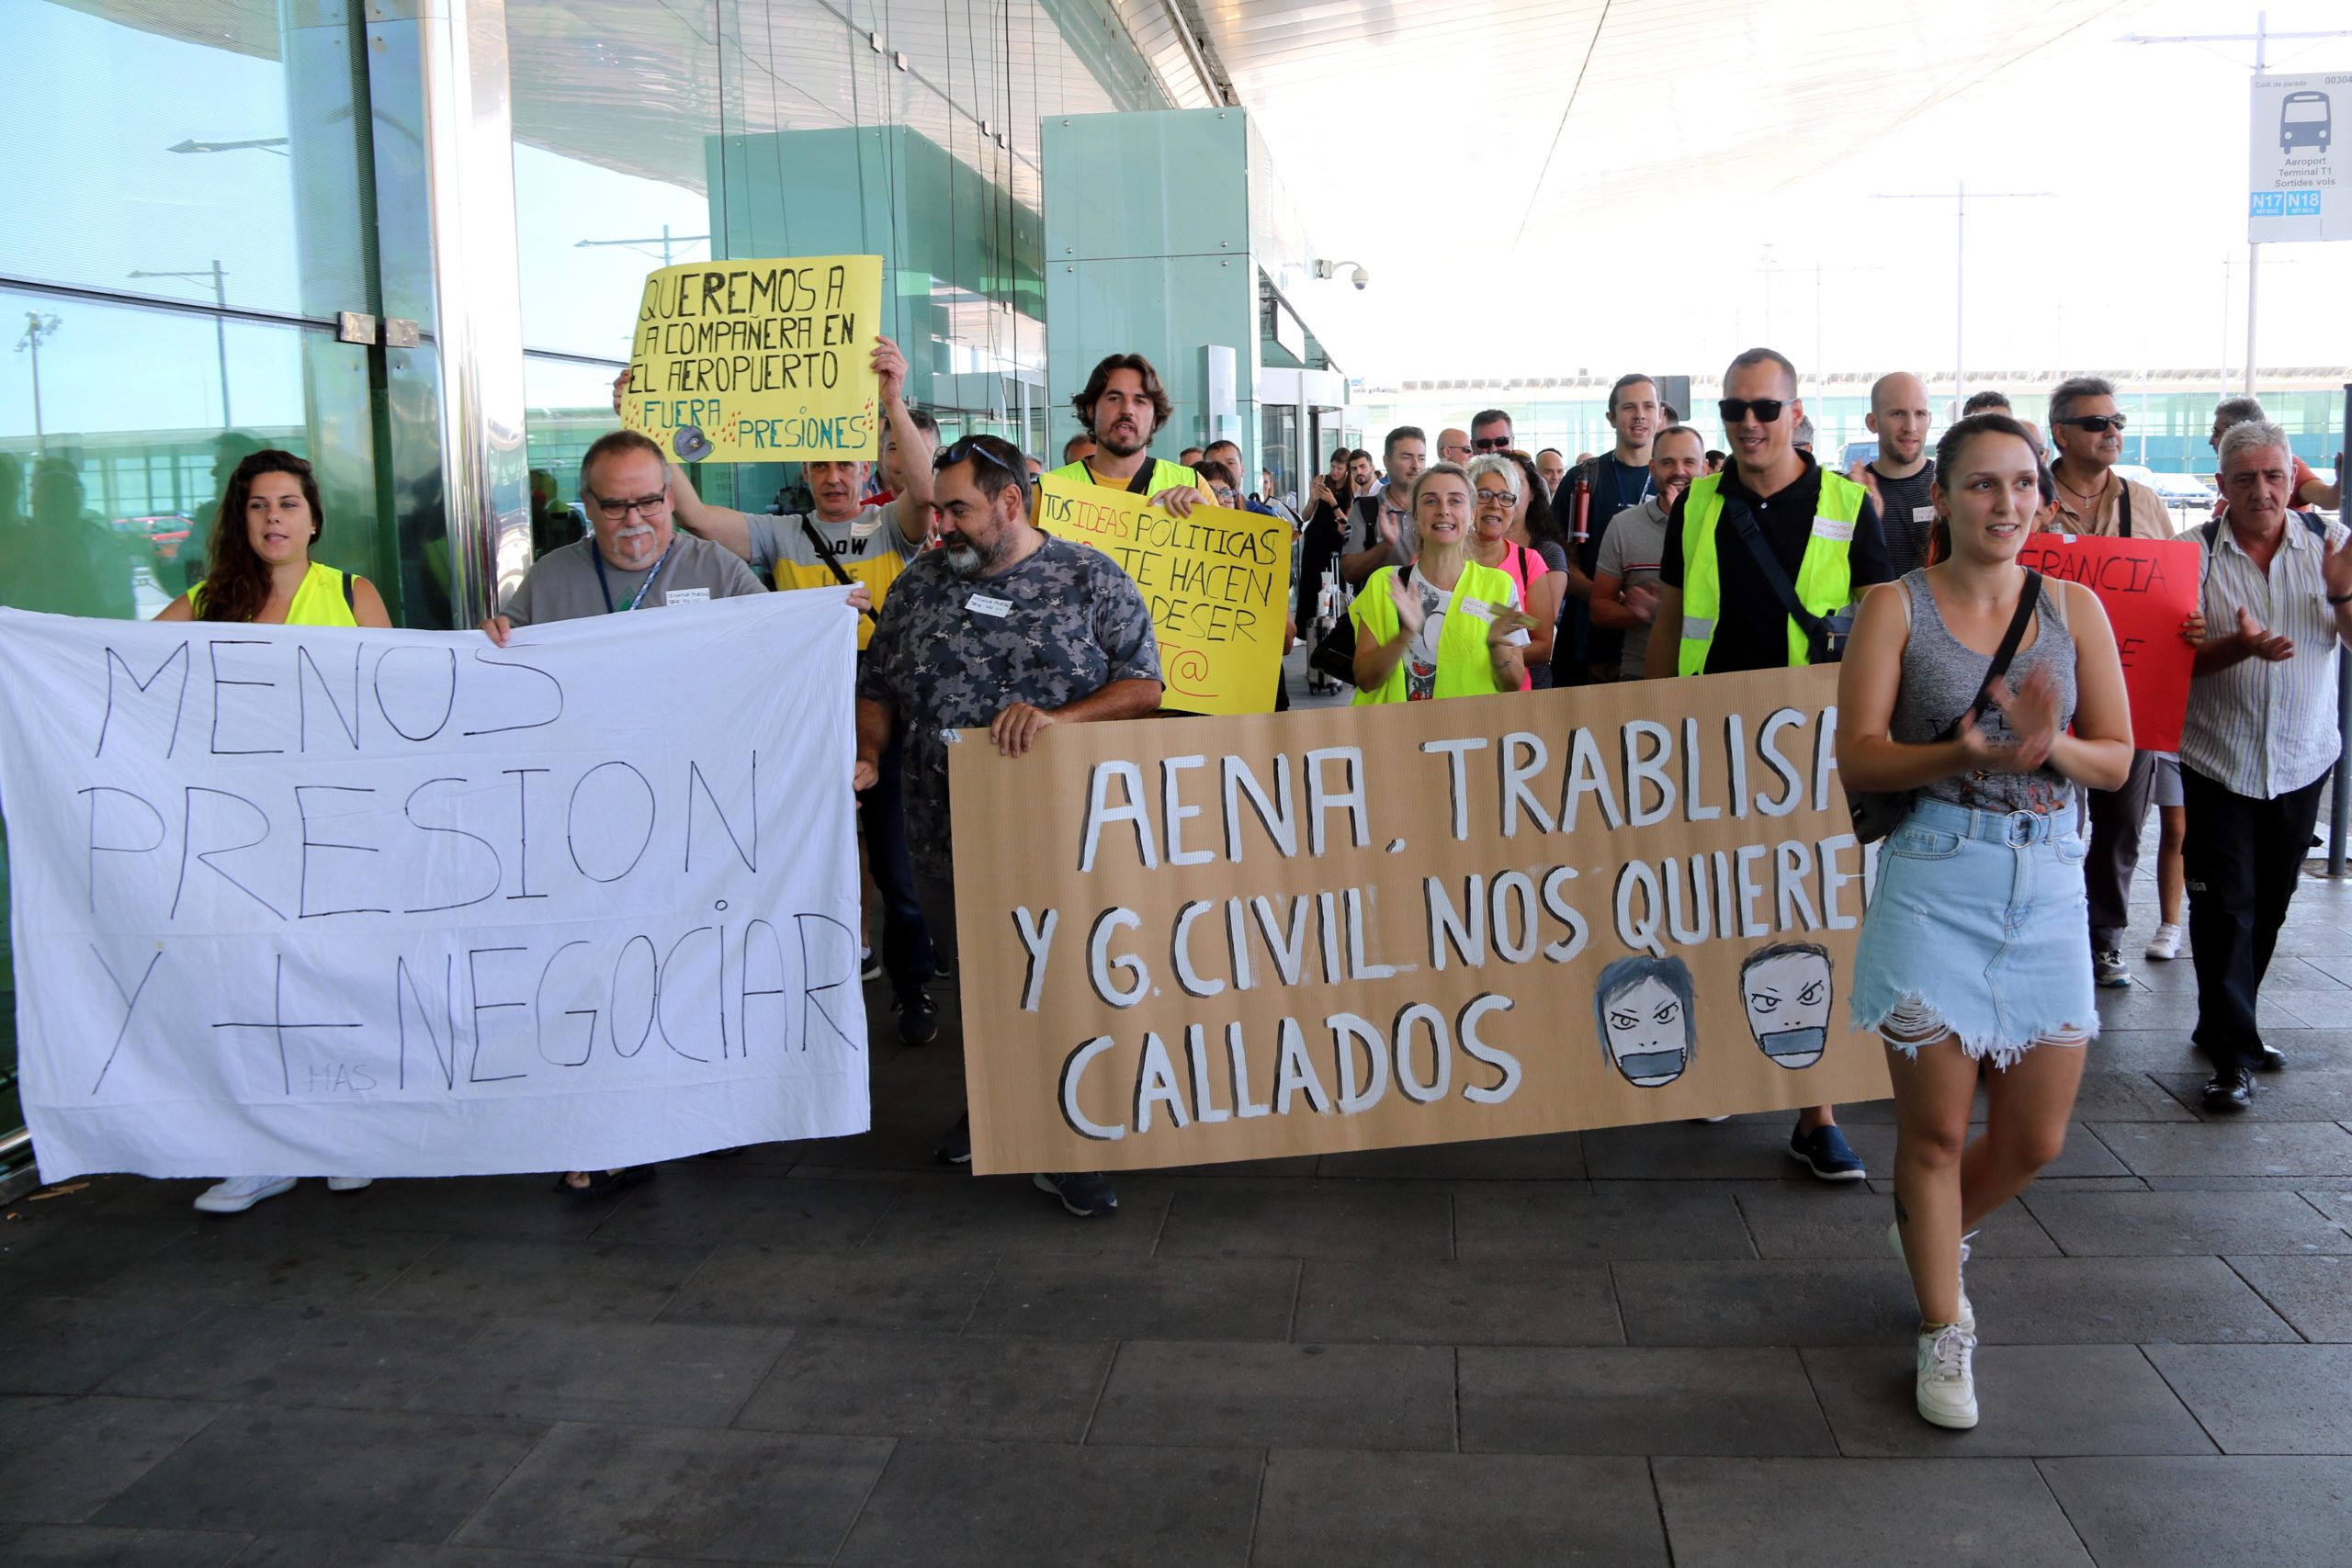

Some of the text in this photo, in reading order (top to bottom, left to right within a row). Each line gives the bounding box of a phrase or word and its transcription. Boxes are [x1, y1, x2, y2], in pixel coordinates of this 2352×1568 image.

[2283, 80, 2307, 88] parada
[2275, 177, 2336, 187] Sortides vols
[2278, 167, 2332, 177] Terminal T1
[2285, 157, 2326, 166] Aeroport
[2253, 194, 2283, 208] N17
[2288, 193, 2320, 207] N18
[639, 265, 845, 321] QUEREMOS A
[633, 312, 855, 357] LA COMPAÑERA EN
[628, 351, 839, 394] EL AEROPUERTO
[643, 399, 721, 428] FUERA
[738, 406, 868, 449] PRESIONES
[1044, 493, 1075, 523] TUS
[1073, 500, 1131, 538] IDEAS
[1135, 513, 1280, 565] POLITICAS
[1114, 547, 1273, 607] TE HACEN
[95, 640, 564, 760] MENOS
[78, 750, 759, 921] PRESION
[1012, 906, 1059, 1012] Y
[1423, 864, 1589, 972] NOS
[90, 943, 163, 1096] Y
[397, 900, 860, 1091] NEGOCIAR
[1057, 992, 1522, 1141] CALLADOS
